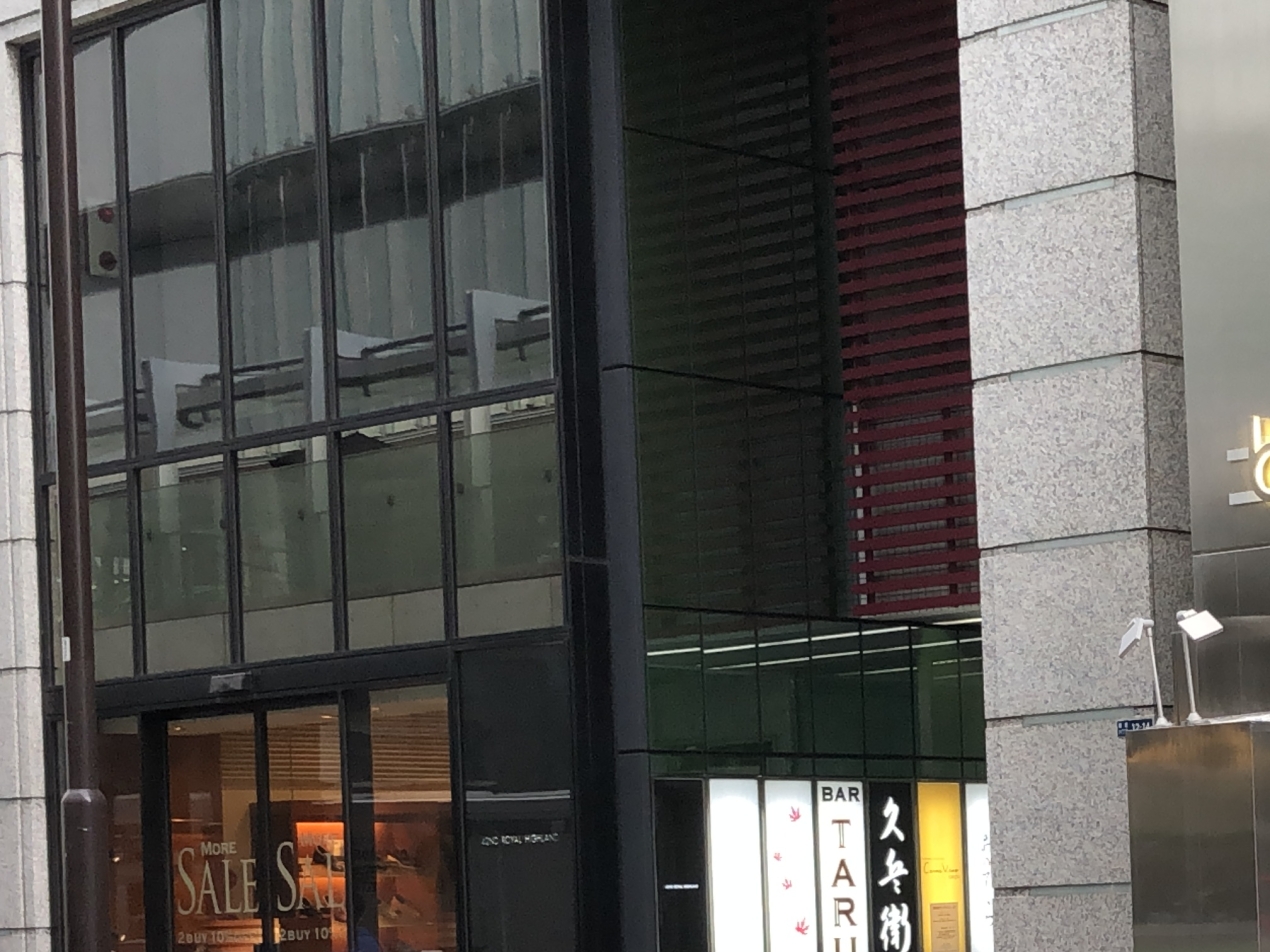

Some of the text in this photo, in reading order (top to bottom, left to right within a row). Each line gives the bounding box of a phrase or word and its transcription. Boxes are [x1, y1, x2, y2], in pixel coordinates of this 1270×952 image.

[822, 786, 860, 803] BAR
[201, 841, 237, 857] MORE
[177, 847, 260, 916] SALE
